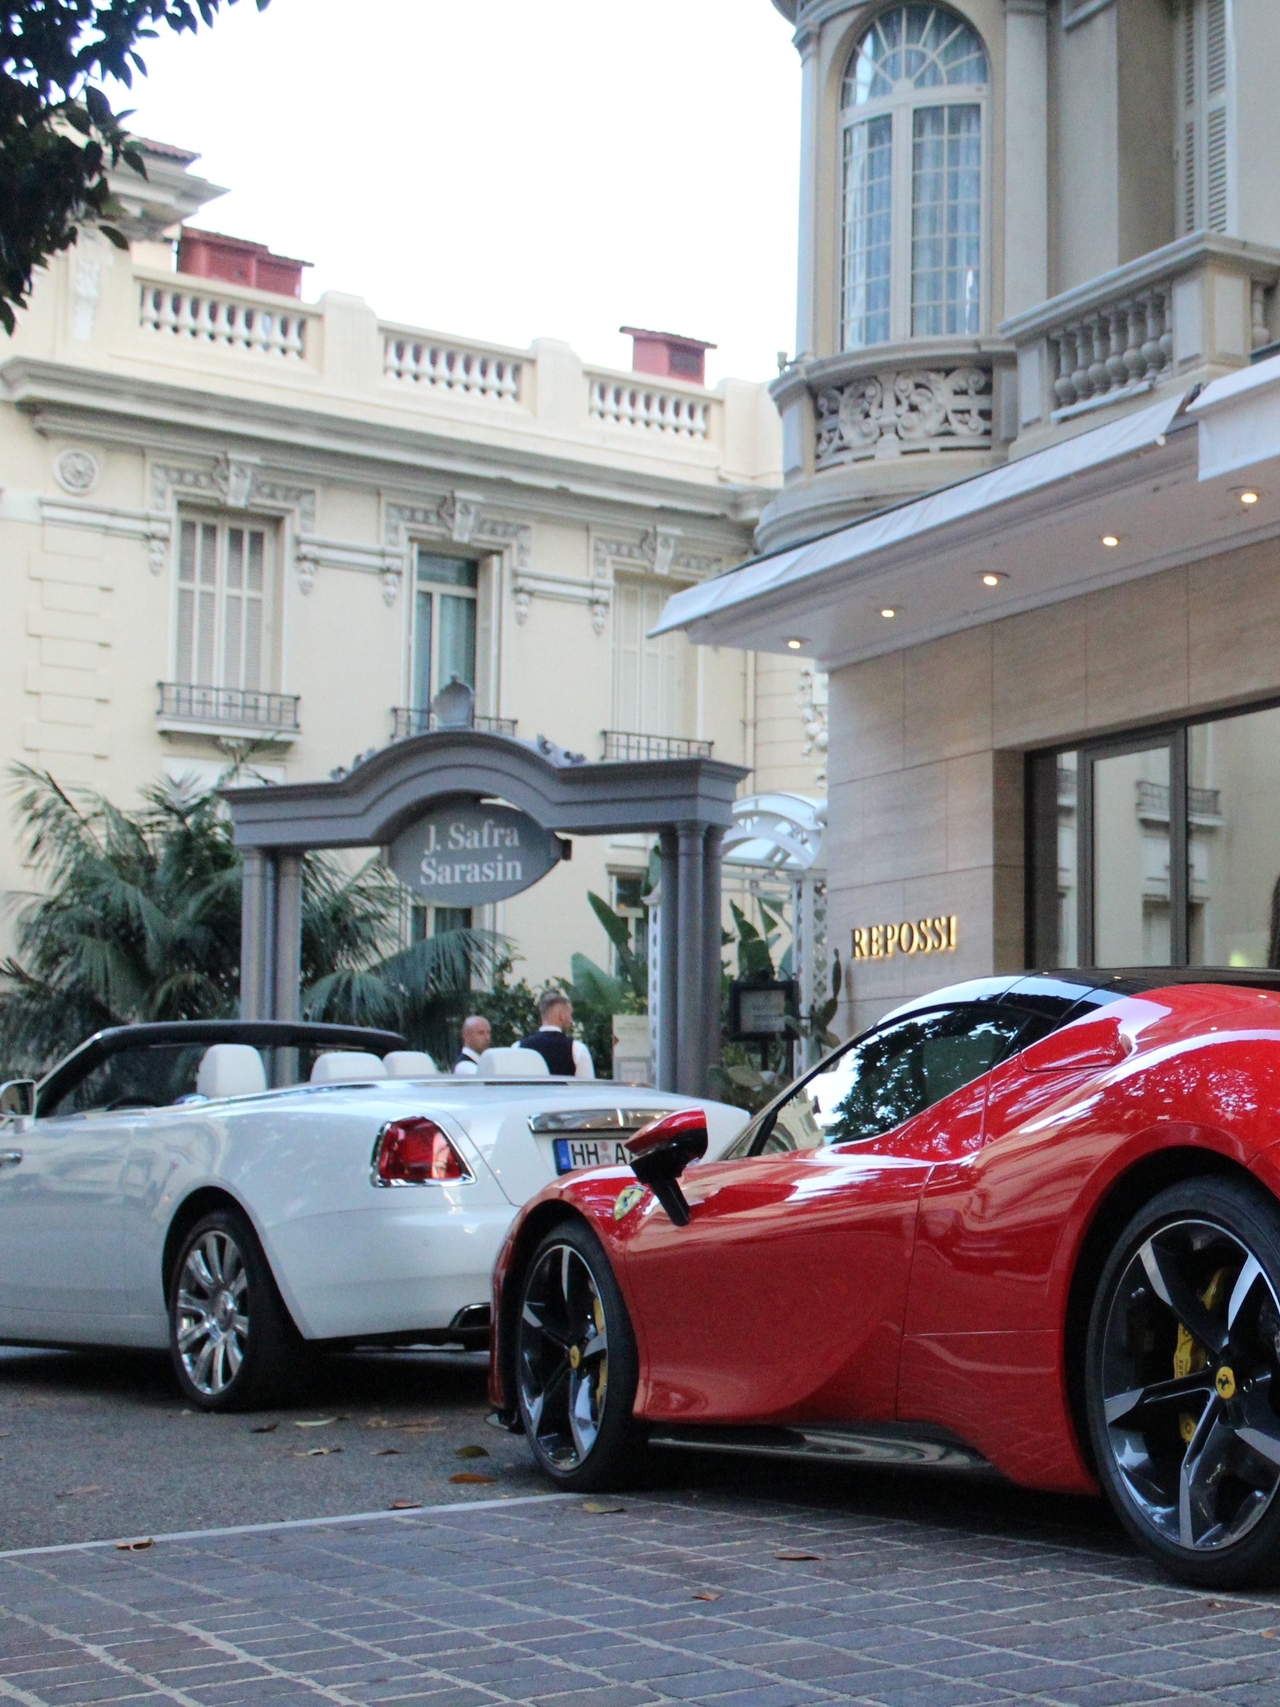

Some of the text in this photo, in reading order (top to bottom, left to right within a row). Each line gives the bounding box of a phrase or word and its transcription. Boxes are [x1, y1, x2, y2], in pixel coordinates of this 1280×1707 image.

[424, 819, 520, 855] J. Safra
[419, 854, 523, 886] Sarasin
[851, 915, 957, 959] REPOSSI
[571, 1143, 599, 1165] HH
